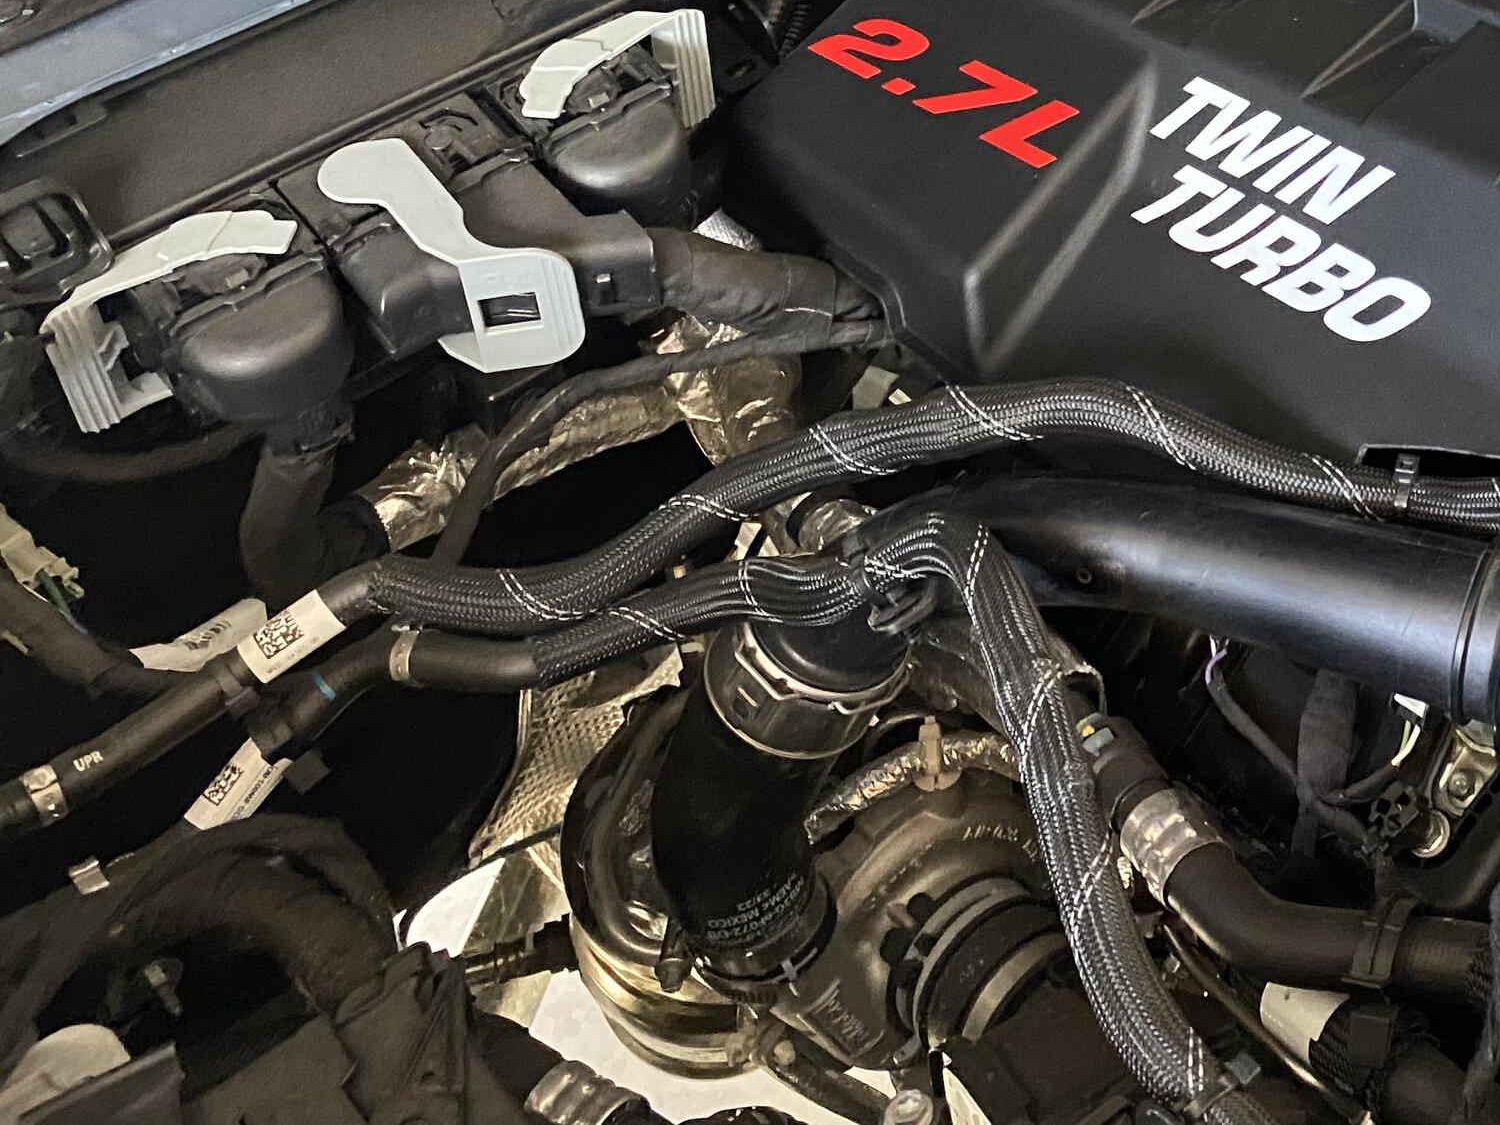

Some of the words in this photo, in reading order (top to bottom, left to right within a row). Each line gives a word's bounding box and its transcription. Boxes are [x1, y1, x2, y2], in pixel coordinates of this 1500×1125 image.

[808, 17, 1080, 168] 2.7L
[1150, 77, 1397, 226] TWIN
[1131, 170, 1432, 342] TURBO
[73, 751, 104, 772] UPR
